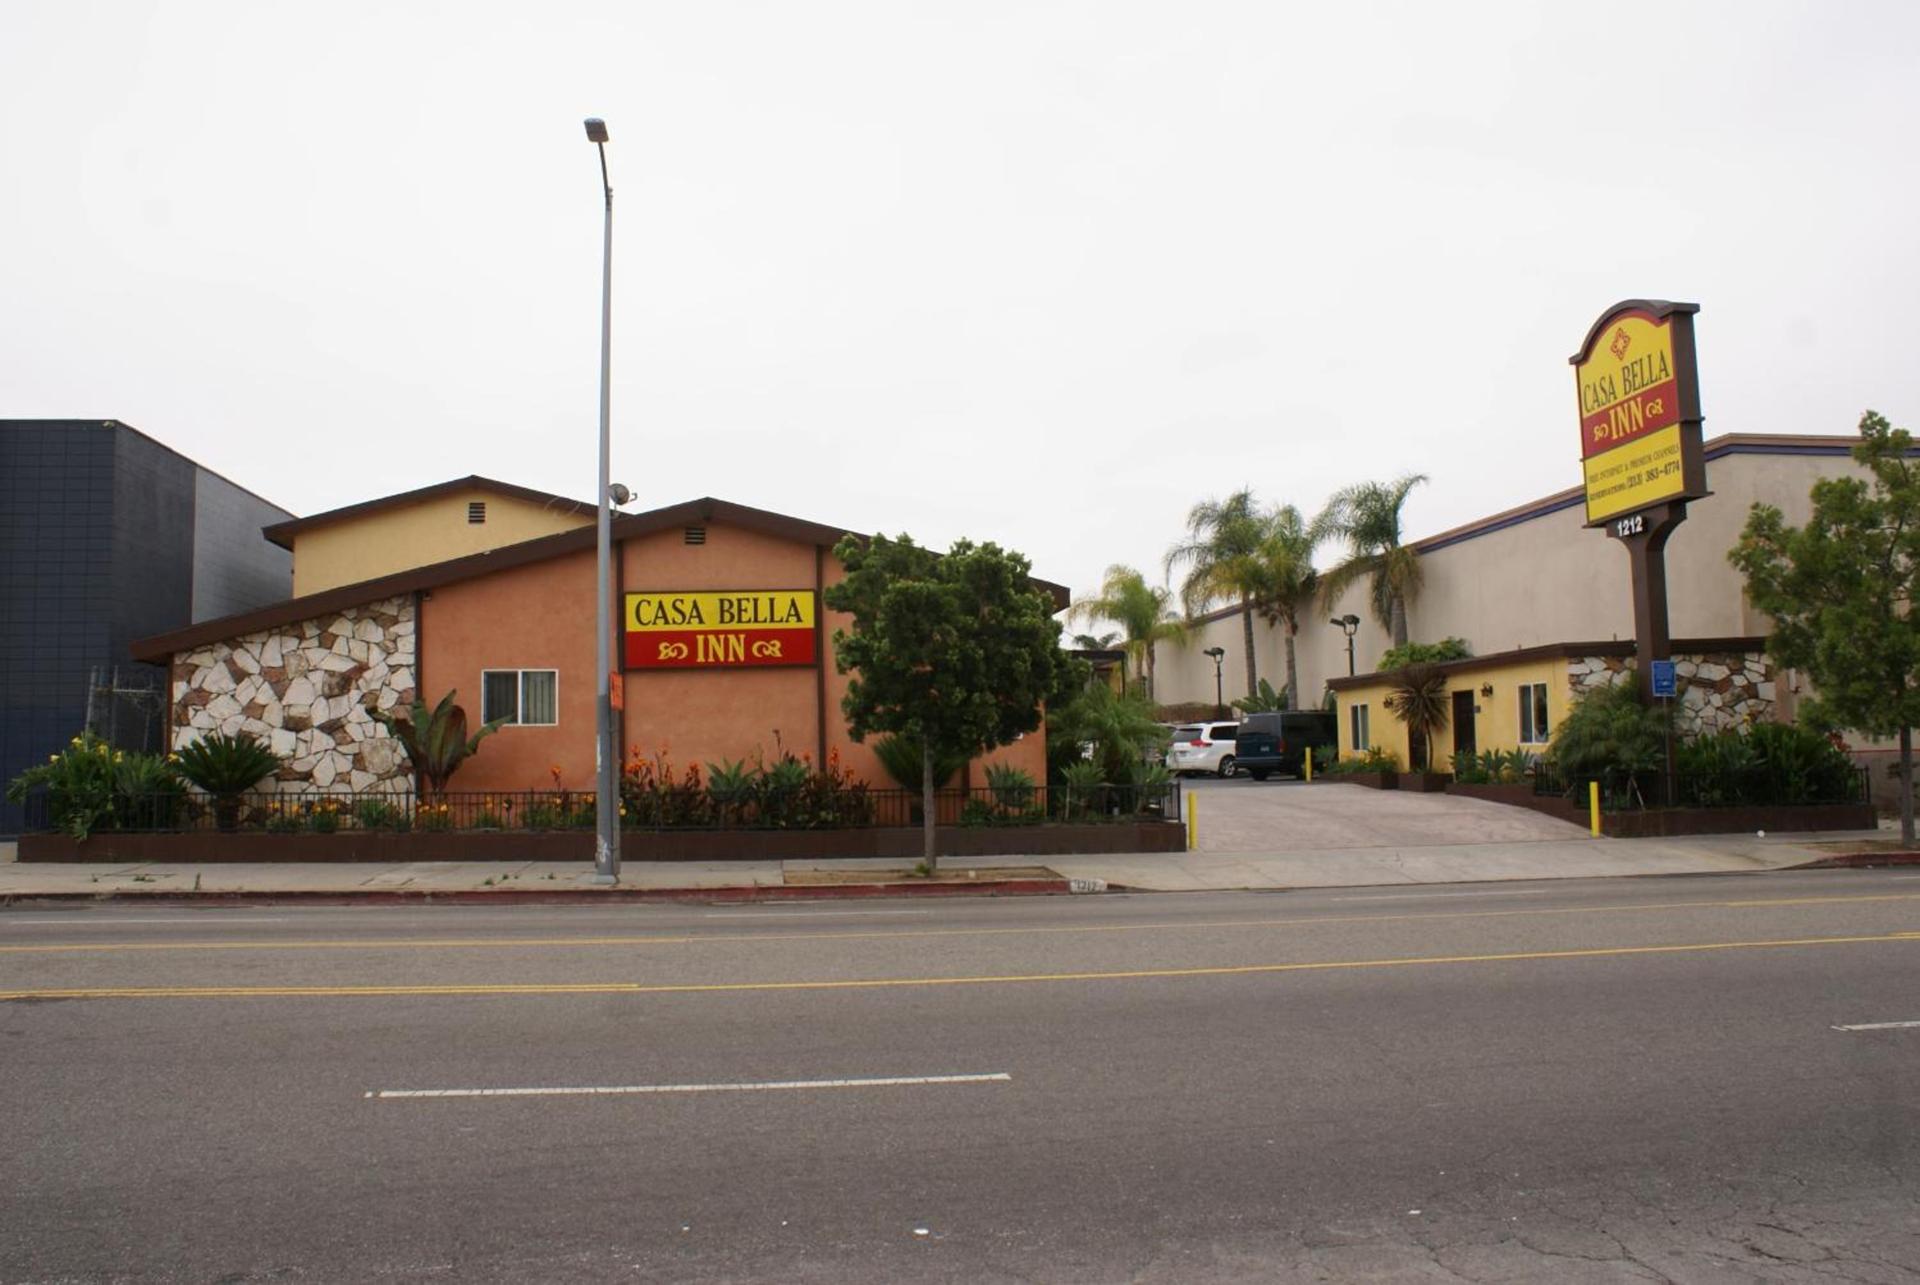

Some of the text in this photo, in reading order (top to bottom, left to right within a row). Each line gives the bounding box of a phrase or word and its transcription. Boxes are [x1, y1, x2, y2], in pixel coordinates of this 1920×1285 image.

[1583, 350, 1670, 413] CASA BELLA
[1609, 397, 1644, 439] INN
[1617, 515, 1643, 537] 1212
[635, 597, 803, 626] CASA BELLA
[696, 634, 746, 662] INN
